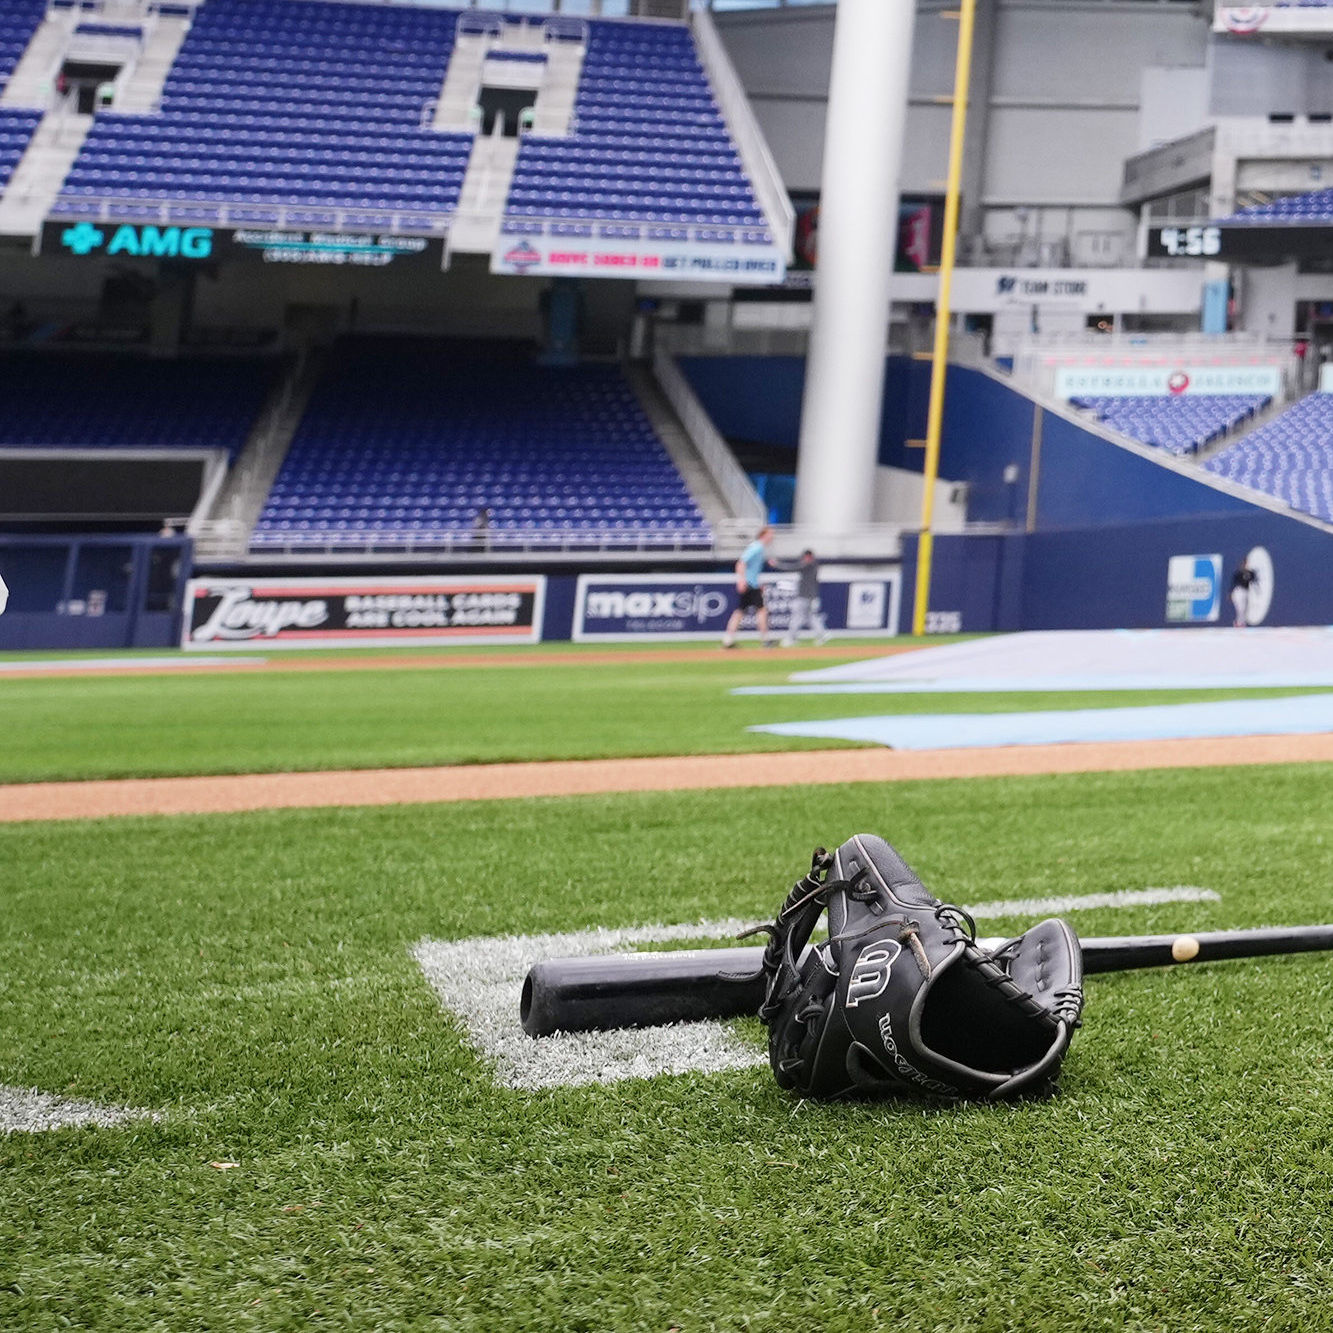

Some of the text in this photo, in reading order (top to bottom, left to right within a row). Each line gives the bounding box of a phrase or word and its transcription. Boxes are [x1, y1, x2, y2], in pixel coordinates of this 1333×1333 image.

[107, 223, 213, 259] AMG
[1160, 227, 1222, 256] 4:56
[344, 592, 522, 612] BASEBALL CARDS
[587, 585, 727, 623] maxsip
[346, 608, 517, 628] ARE COOL AGAIN
